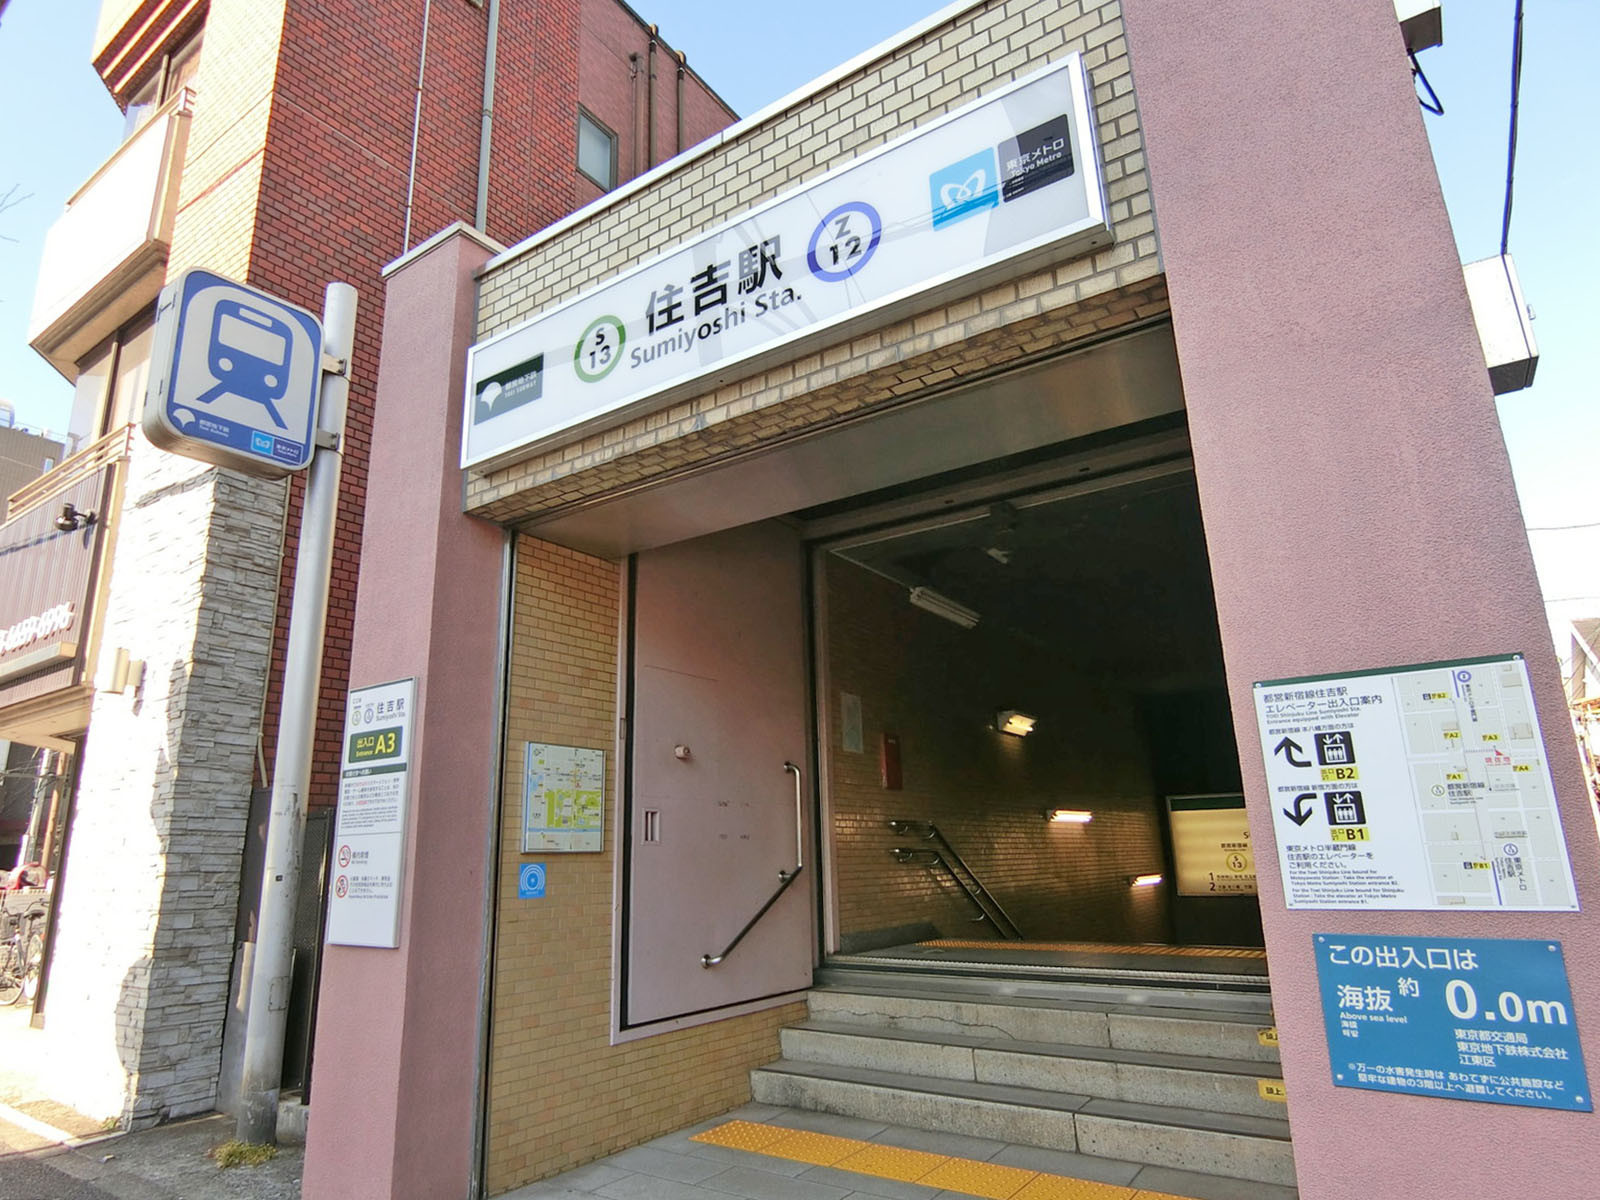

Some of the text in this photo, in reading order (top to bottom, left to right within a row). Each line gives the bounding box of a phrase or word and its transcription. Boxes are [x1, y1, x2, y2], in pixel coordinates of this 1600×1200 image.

[1006, 138, 1064, 171] 東京メトロ
[1010, 152, 1062, 177] Tokyo Metro
[833, 215, 852, 238] Z
[829, 235, 862, 266] 12
[645, 234, 782, 335] 住吉駅
[595, 327, 605, 346] S
[630, 286, 802, 368] Sumiyoshi Sta.
[589, 345, 611, 369] 13
[1263, 686, 1348, 703] 都営新宿線住吉駅
[1266, 694, 1383, 714] エレベーター出入口案内
[377, 698, 404, 714] 住吉駅
[375, 732, 396, 754] A3
[1336, 767, 1355, 779] B2
[1346, 828, 1364, 840] B1
[1287, 852, 1374, 861] 住吉駅のエレベーターを
[1289, 861, 1347, 869] ご利用ください。
[1209, 872, 1214, 881] 1
[1209, 882, 1216, 891] 2
[1329, 944, 1479, 970] この出入口は
[1336, 976, 1568, 1025] 海抜 約 0.0m
[1340, 1011, 1367, 1021] Above
[1385, 1014, 1408, 1024] level
[1454, 1028, 1528, 1044] 東京都交通局
[1456, 1041, 1569, 1060] 東京地下鉄株式会社
[1459, 1053, 1496, 1067] 江東区
[1448, 1072, 1565, 1091] あわてずに公共施設など
